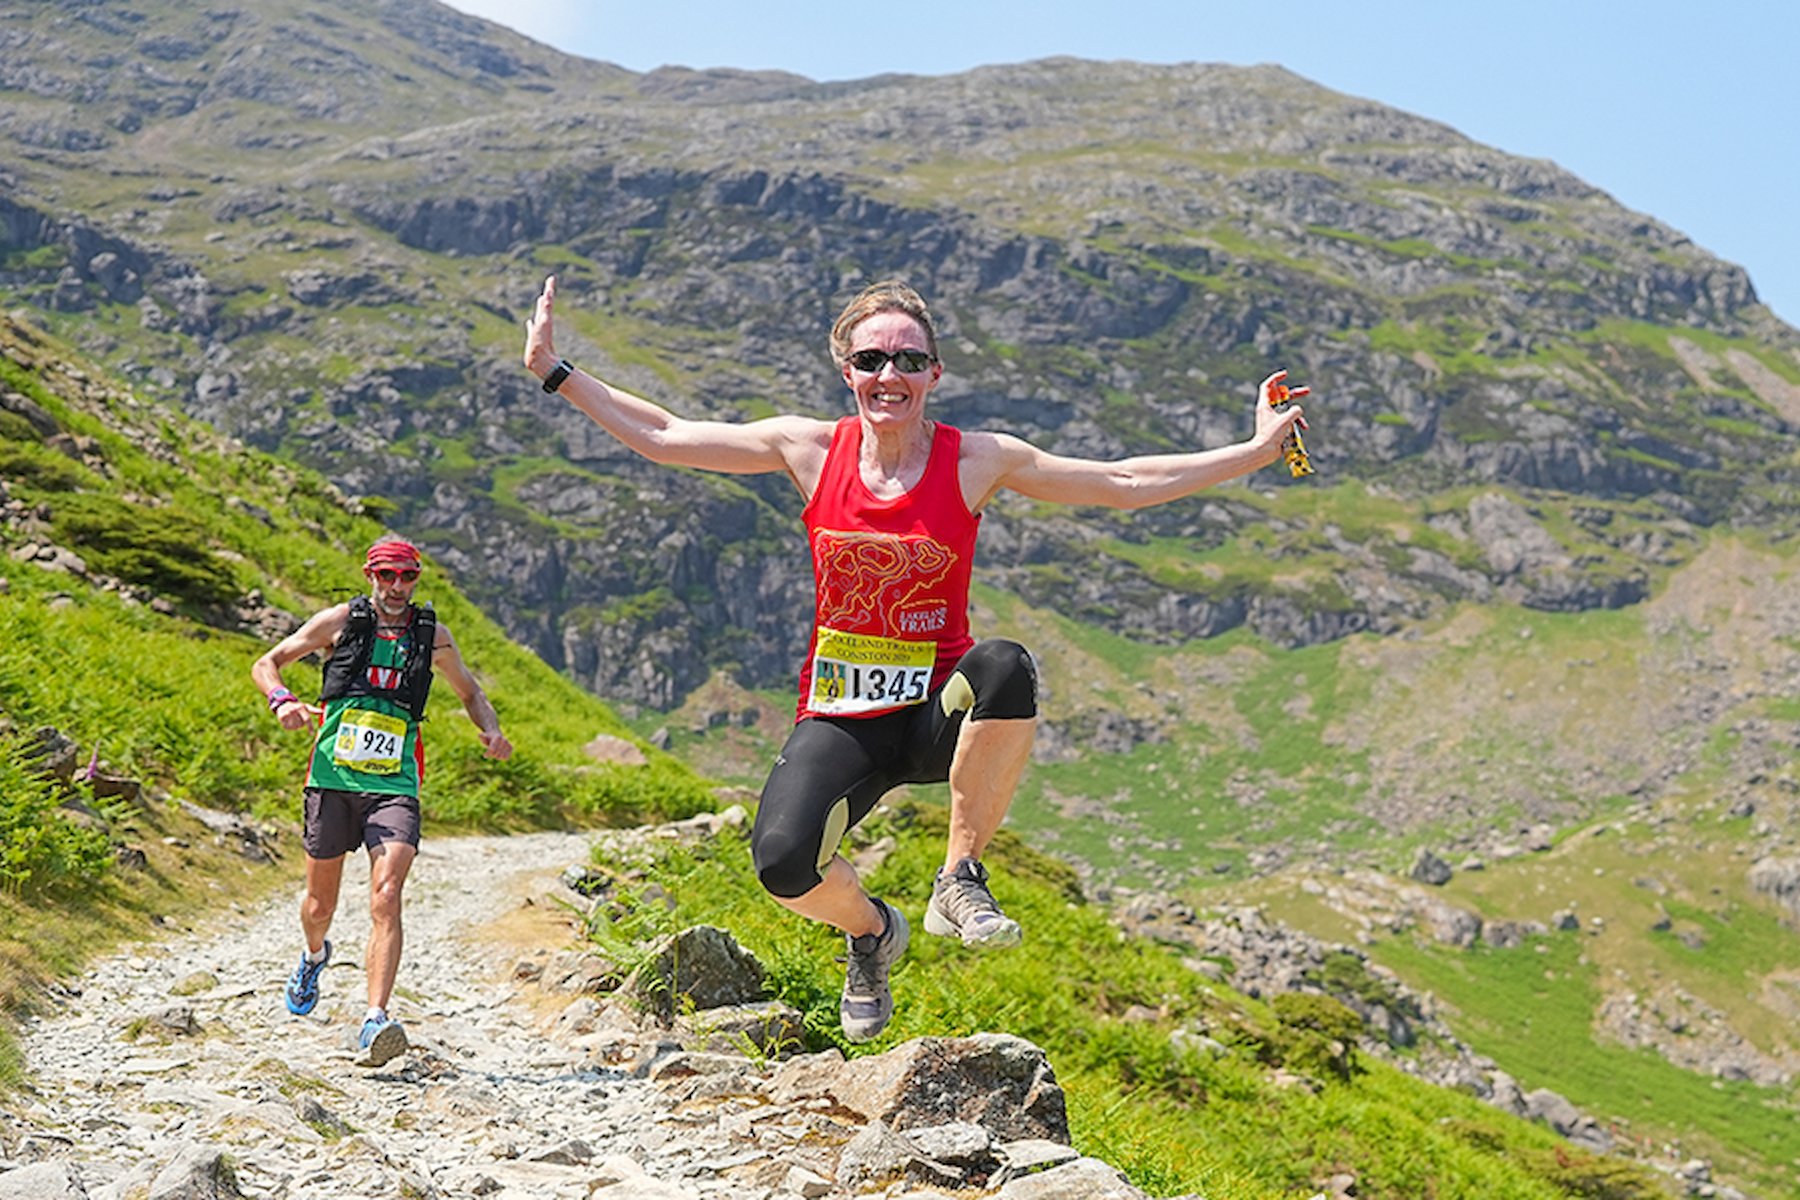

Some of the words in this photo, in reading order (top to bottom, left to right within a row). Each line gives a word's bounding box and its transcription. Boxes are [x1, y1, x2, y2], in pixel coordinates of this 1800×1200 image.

[901, 617, 946, 632] TRAILS
[886, 641, 924, 653] TRAILS
[836, 648, 890, 662] CONISTON
[852, 668, 928, 701] 1345
[363, 730, 395, 756] 924
